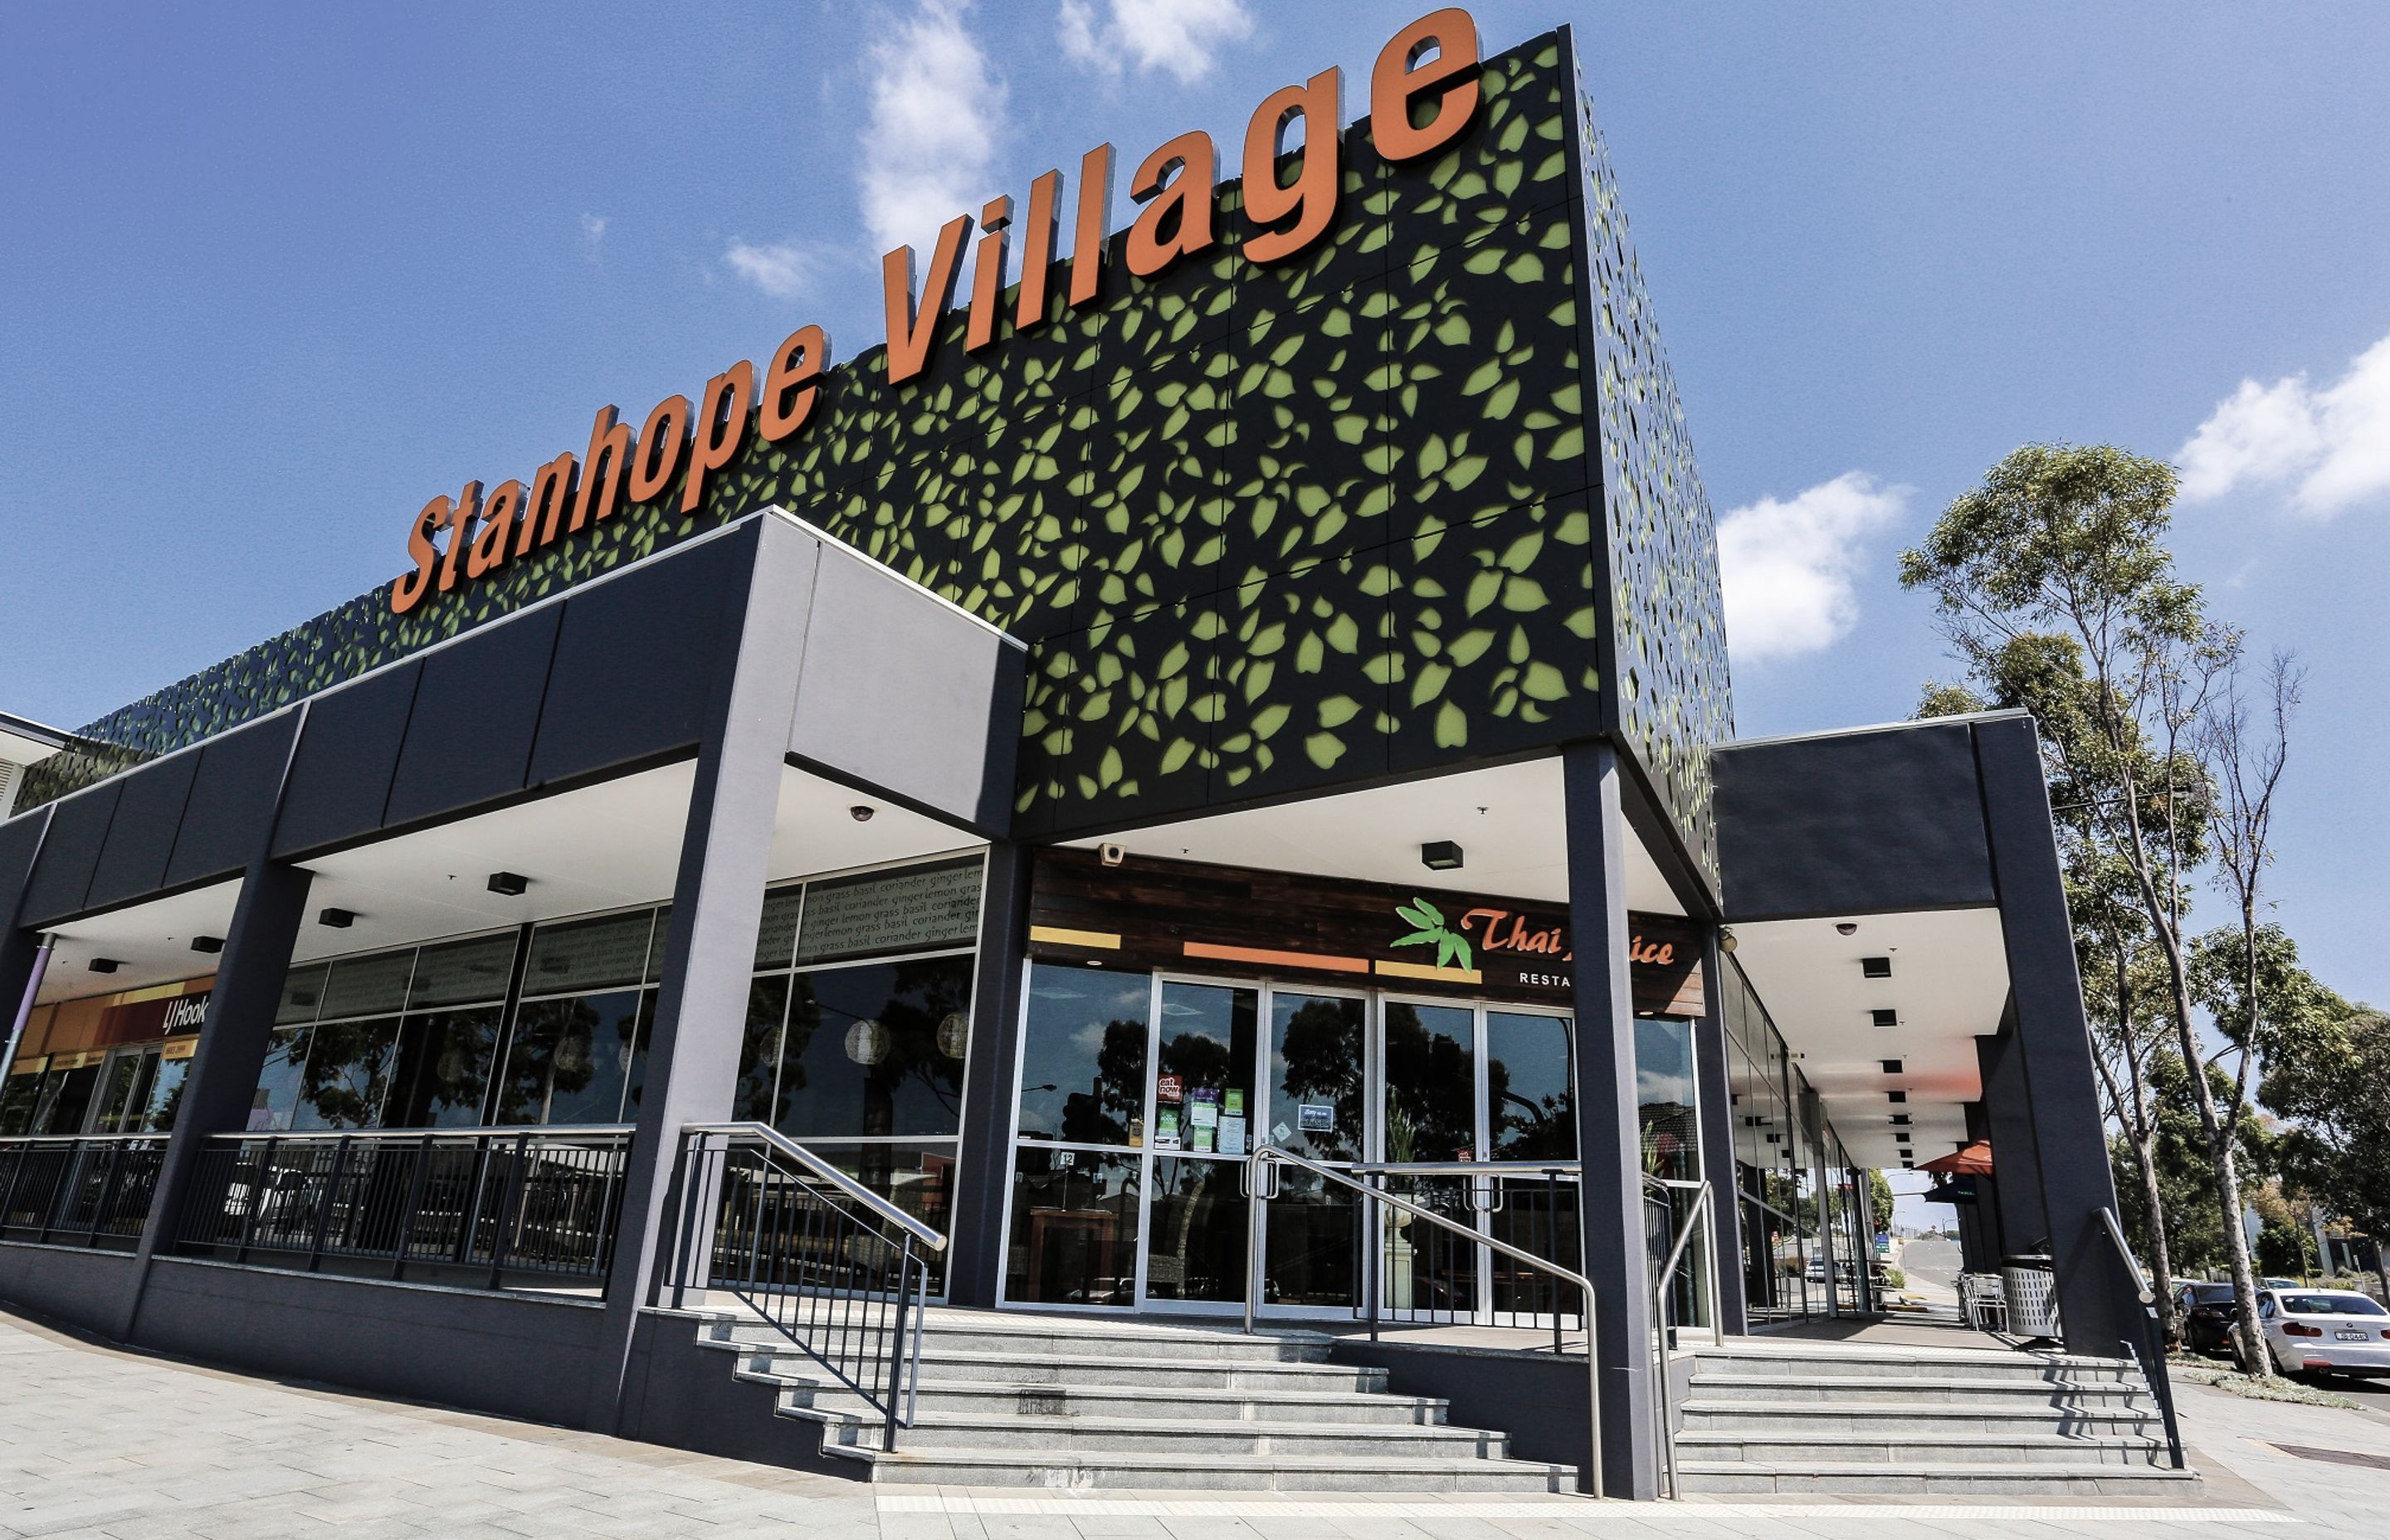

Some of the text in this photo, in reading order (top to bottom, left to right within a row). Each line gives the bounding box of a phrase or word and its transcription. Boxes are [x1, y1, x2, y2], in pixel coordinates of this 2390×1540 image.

[391, 7, 1482, 614] Stanhope Village
[819, 903, 840, 914] basil
[844, 895, 888, 911] coriander
[892, 892, 923, 906] ginger
[925, 888, 957, 899] lemon
[826, 890, 850, 903] grass
[854, 883, 876, 896] basil
[880, 876, 926, 891] coriander
[930, 873, 963, 888] ginger
[842, 913, 871, 924] lemon
[874, 909, 900, 922] grass
[904, 901, 926, 915] basil
[856, 924, 880, 937] grass
[885, 916, 907, 929] basil
[913, 909, 961, 925] coriander
[820, 942, 844, 953] grass
[847, 934, 870, 948] basil
[875, 928, 920, 943] coriander
[924, 925, 958, 942] ginger
[1461, 909, 1562, 954] Thai
[1519, 972, 1572, 987] RESTA
[163, 995, 209, 1035] LJ Hook
[1159, 1078, 1175, 1086] eat
[1063, 1153, 1073, 1163] 12
